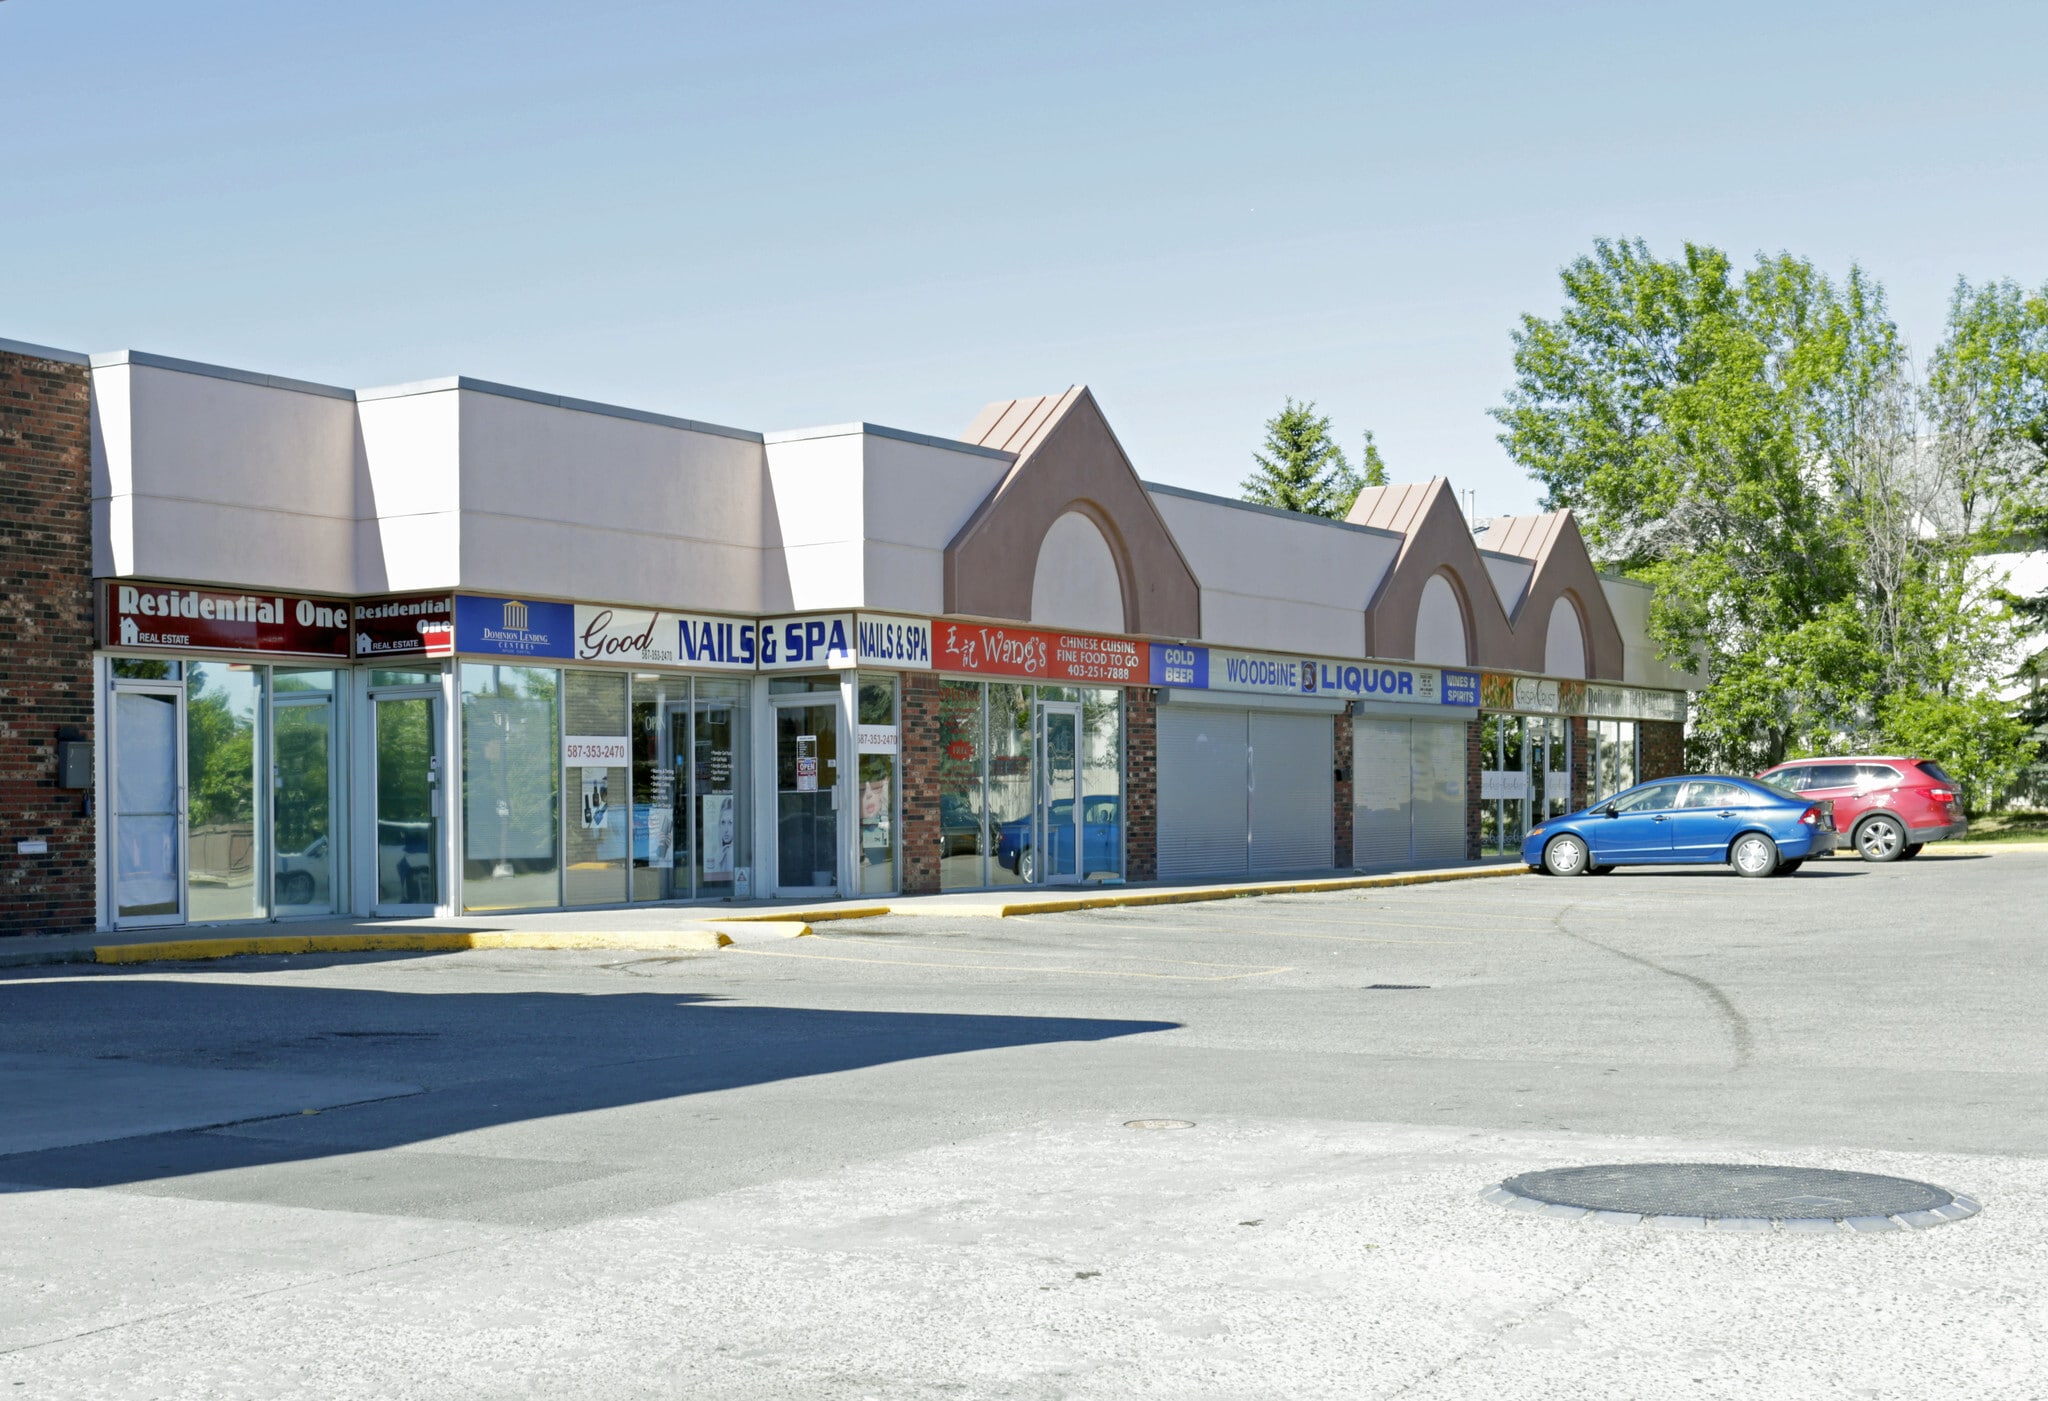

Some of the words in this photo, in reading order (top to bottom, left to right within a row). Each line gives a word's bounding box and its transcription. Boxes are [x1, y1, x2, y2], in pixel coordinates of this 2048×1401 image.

[119, 585, 285, 626] Residential
[295, 599, 348, 630] One
[354, 598, 451, 621] Residential
[416, 618, 452, 635] One
[484, 627, 518, 641] DOMINION
[519, 630, 548, 643] LENDING
[139, 632, 160, 643] REAL
[161, 633, 191, 645] ESTATE
[372, 641, 391, 651] REAL
[392, 639, 419, 649] ESTATE
[579, 609, 659, 660] Good
[679, 619, 756, 664] NAILS
[761, 625, 777, 664] &
[785, 619, 849, 663] SPA
[859, 620, 894, 658] NAILS
[895, 629, 905, 657] &
[906, 625, 928, 662] SPA
[1060, 635, 1098, 650] CHINESE
[1101, 640, 1136, 654] CUISINE
[498, 641, 535, 650] CENTRES
[979, 628, 1047, 673] Wang's
[1056, 649, 1077, 662] FINE
[1080, 652, 1107, 665] FOOD
[1110, 653, 1123, 666] TO
[1125, 655, 1139, 667] GO
[1165, 648, 1195, 666] COLD
[1067, 664, 1130, 680] 403-251-7888
[1165, 667, 1194, 684] BEER
[1226, 657, 1296, 688] WOODBINE
[1321, 663, 1413, 696] LIQUOR
[1446, 674, 1469, 688] WINES
[1469, 676, 1476, 689] &
[1447, 689, 1474, 704] SPIRITS
[567, 744, 625, 759] 587-353-2470
